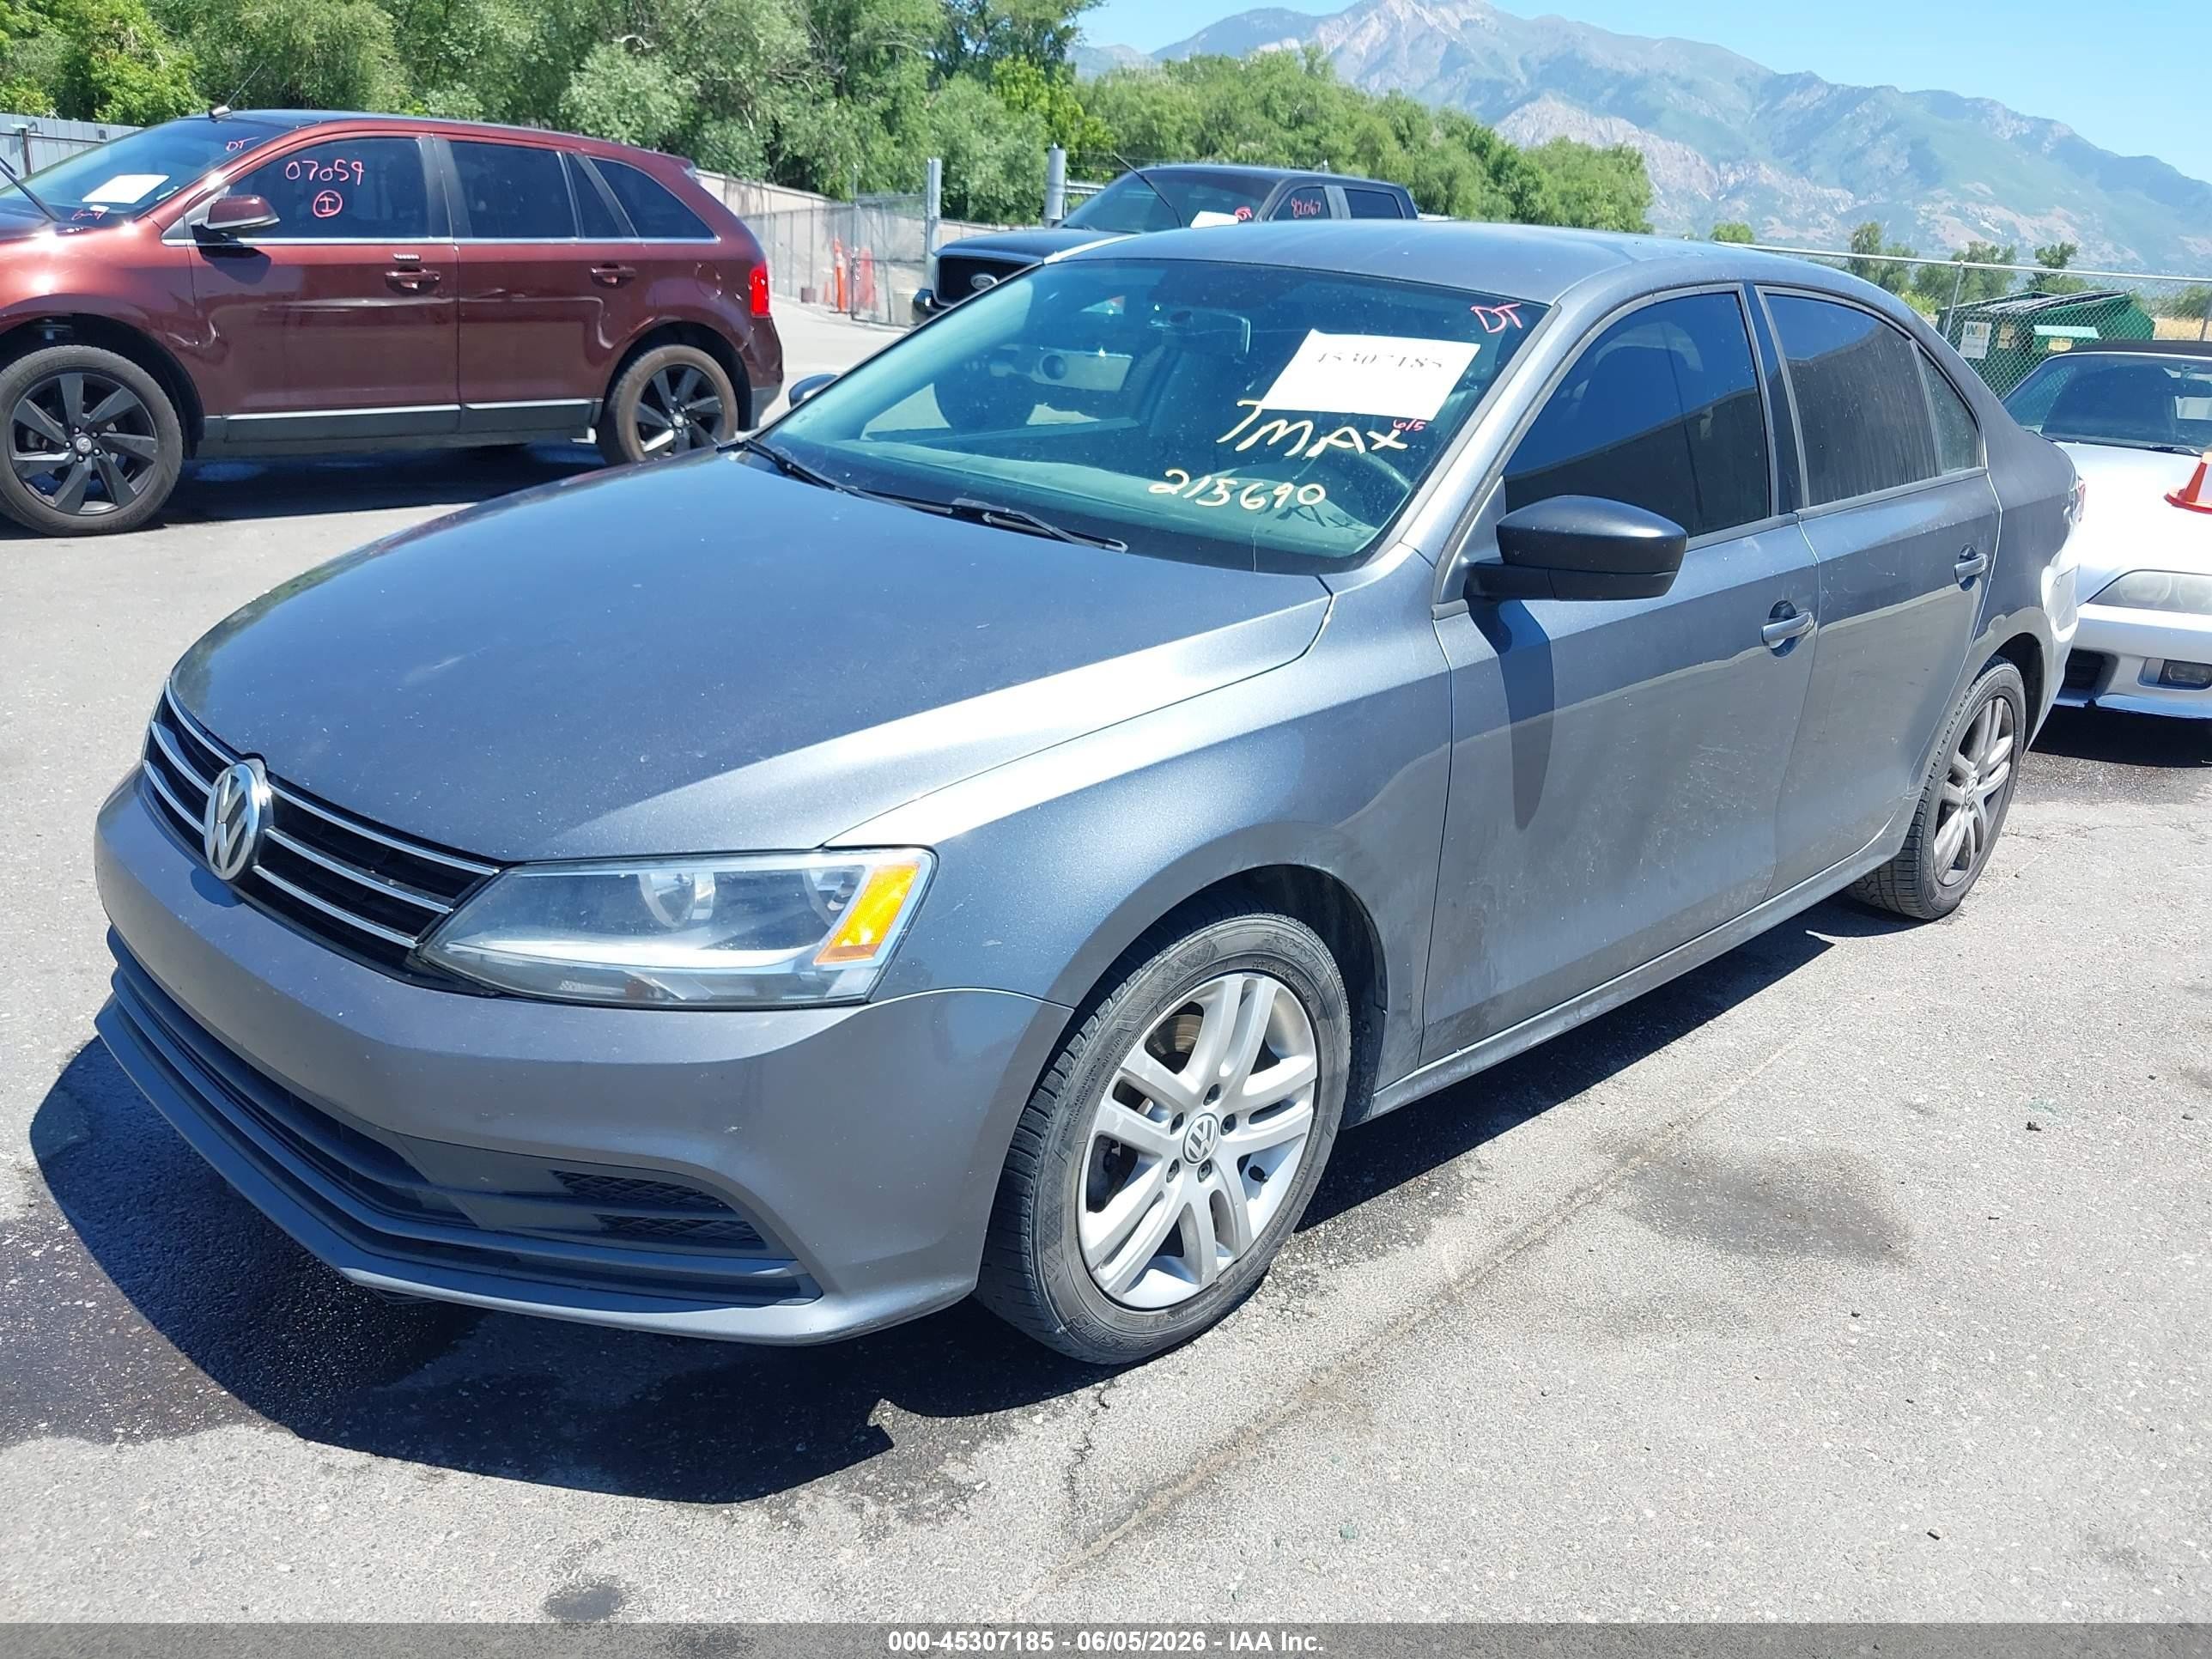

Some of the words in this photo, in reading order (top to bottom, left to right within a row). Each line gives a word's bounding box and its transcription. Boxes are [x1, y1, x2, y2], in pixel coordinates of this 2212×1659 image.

[285, 159, 365, 185] 07059
[1469, 302, 1522, 334] DT
[1148, 469, 1326, 510] 215690
